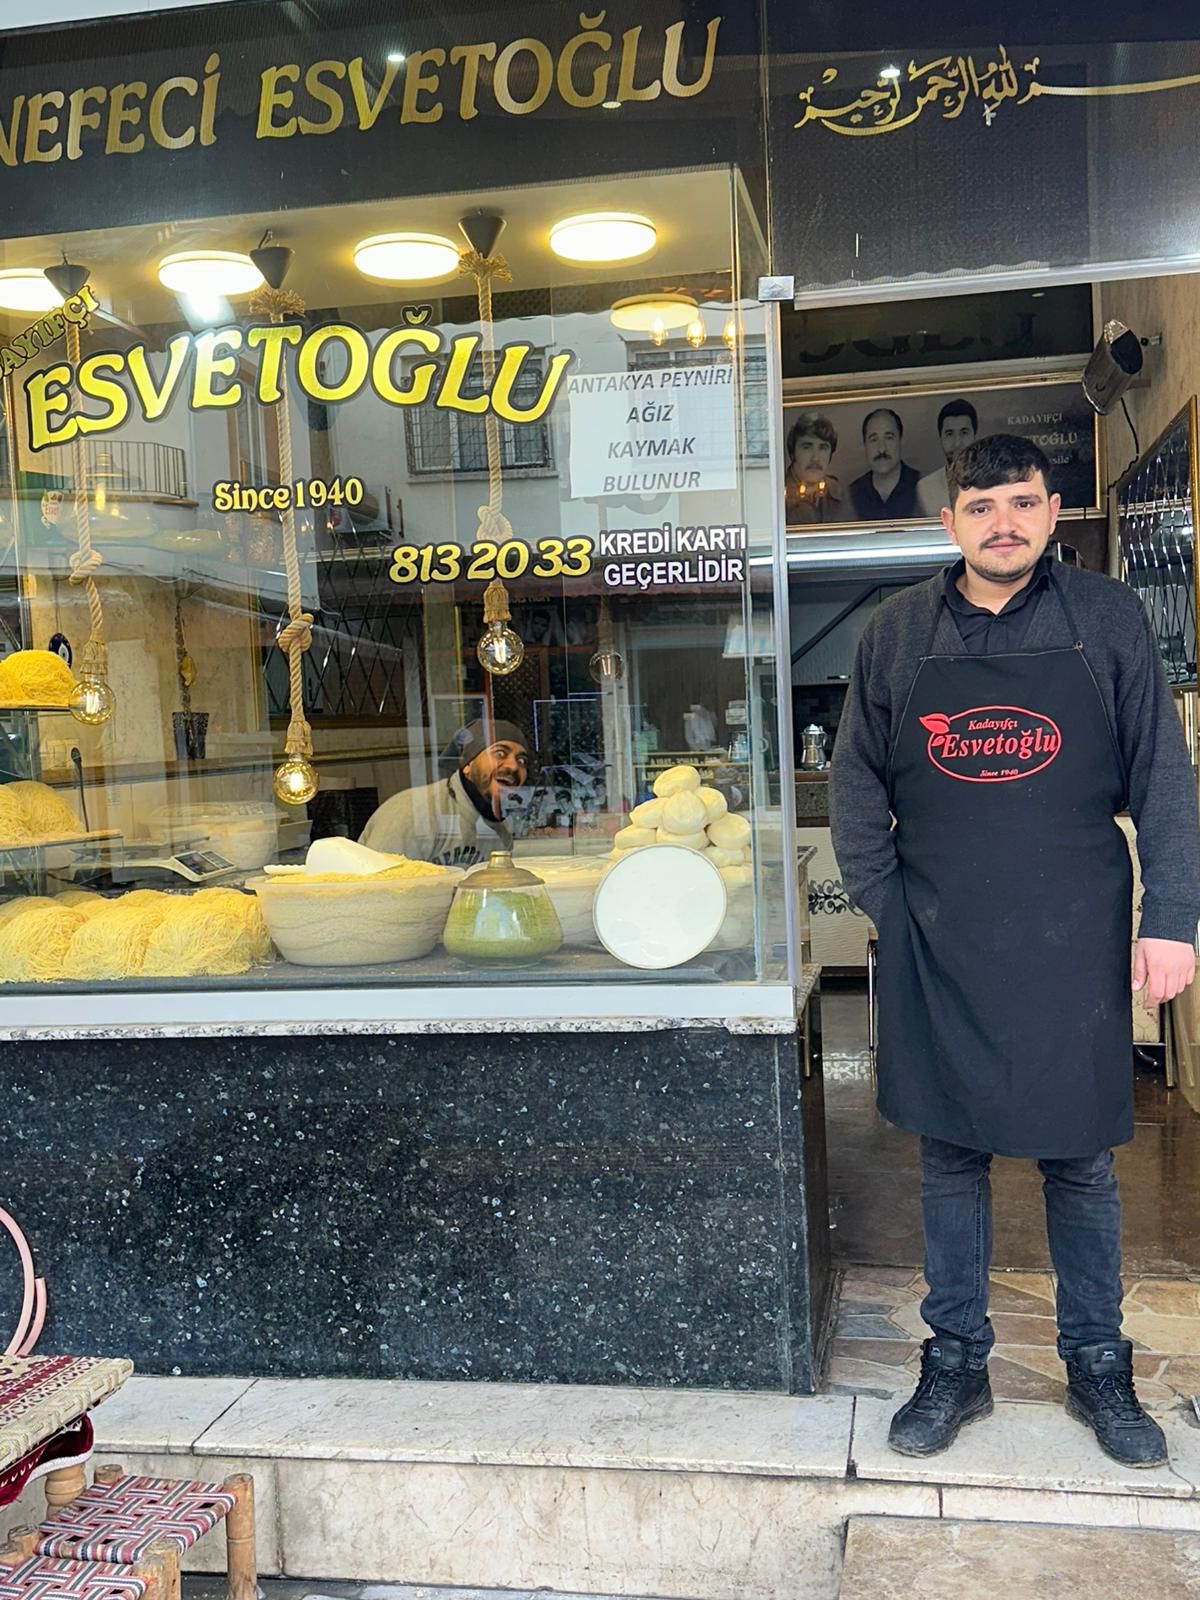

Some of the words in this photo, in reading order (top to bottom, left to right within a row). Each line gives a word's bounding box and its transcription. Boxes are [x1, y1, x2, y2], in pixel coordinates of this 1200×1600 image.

[256, 9, 722, 140] ESVETOĞLU
[0, 285, 100, 380] AYIFÇI
[25, 305, 573, 450] ESVETOĞLU
[568, 374, 655, 394] ANTAKYA
[626, 401, 675, 424] AĞIZ
[608, 437, 697, 459] KAYMAK
[213, 480, 292, 512] Since
[295, 477, 364, 508] 1940
[603, 471, 701, 493] BULUNUR
[600, 526, 670, 556] KREDİ
[676, 527, 746, 552] KARTI
[388, 543, 461, 584] 813
[465, 541, 529, 580] 20
[531, 537, 593, 578] 33
[603, 553, 744, 590] GEÇERLİDİR
[968, 717, 1018, 731] Kadayıfçı
[940, 727, 1057, 760] Esvetoğlu
